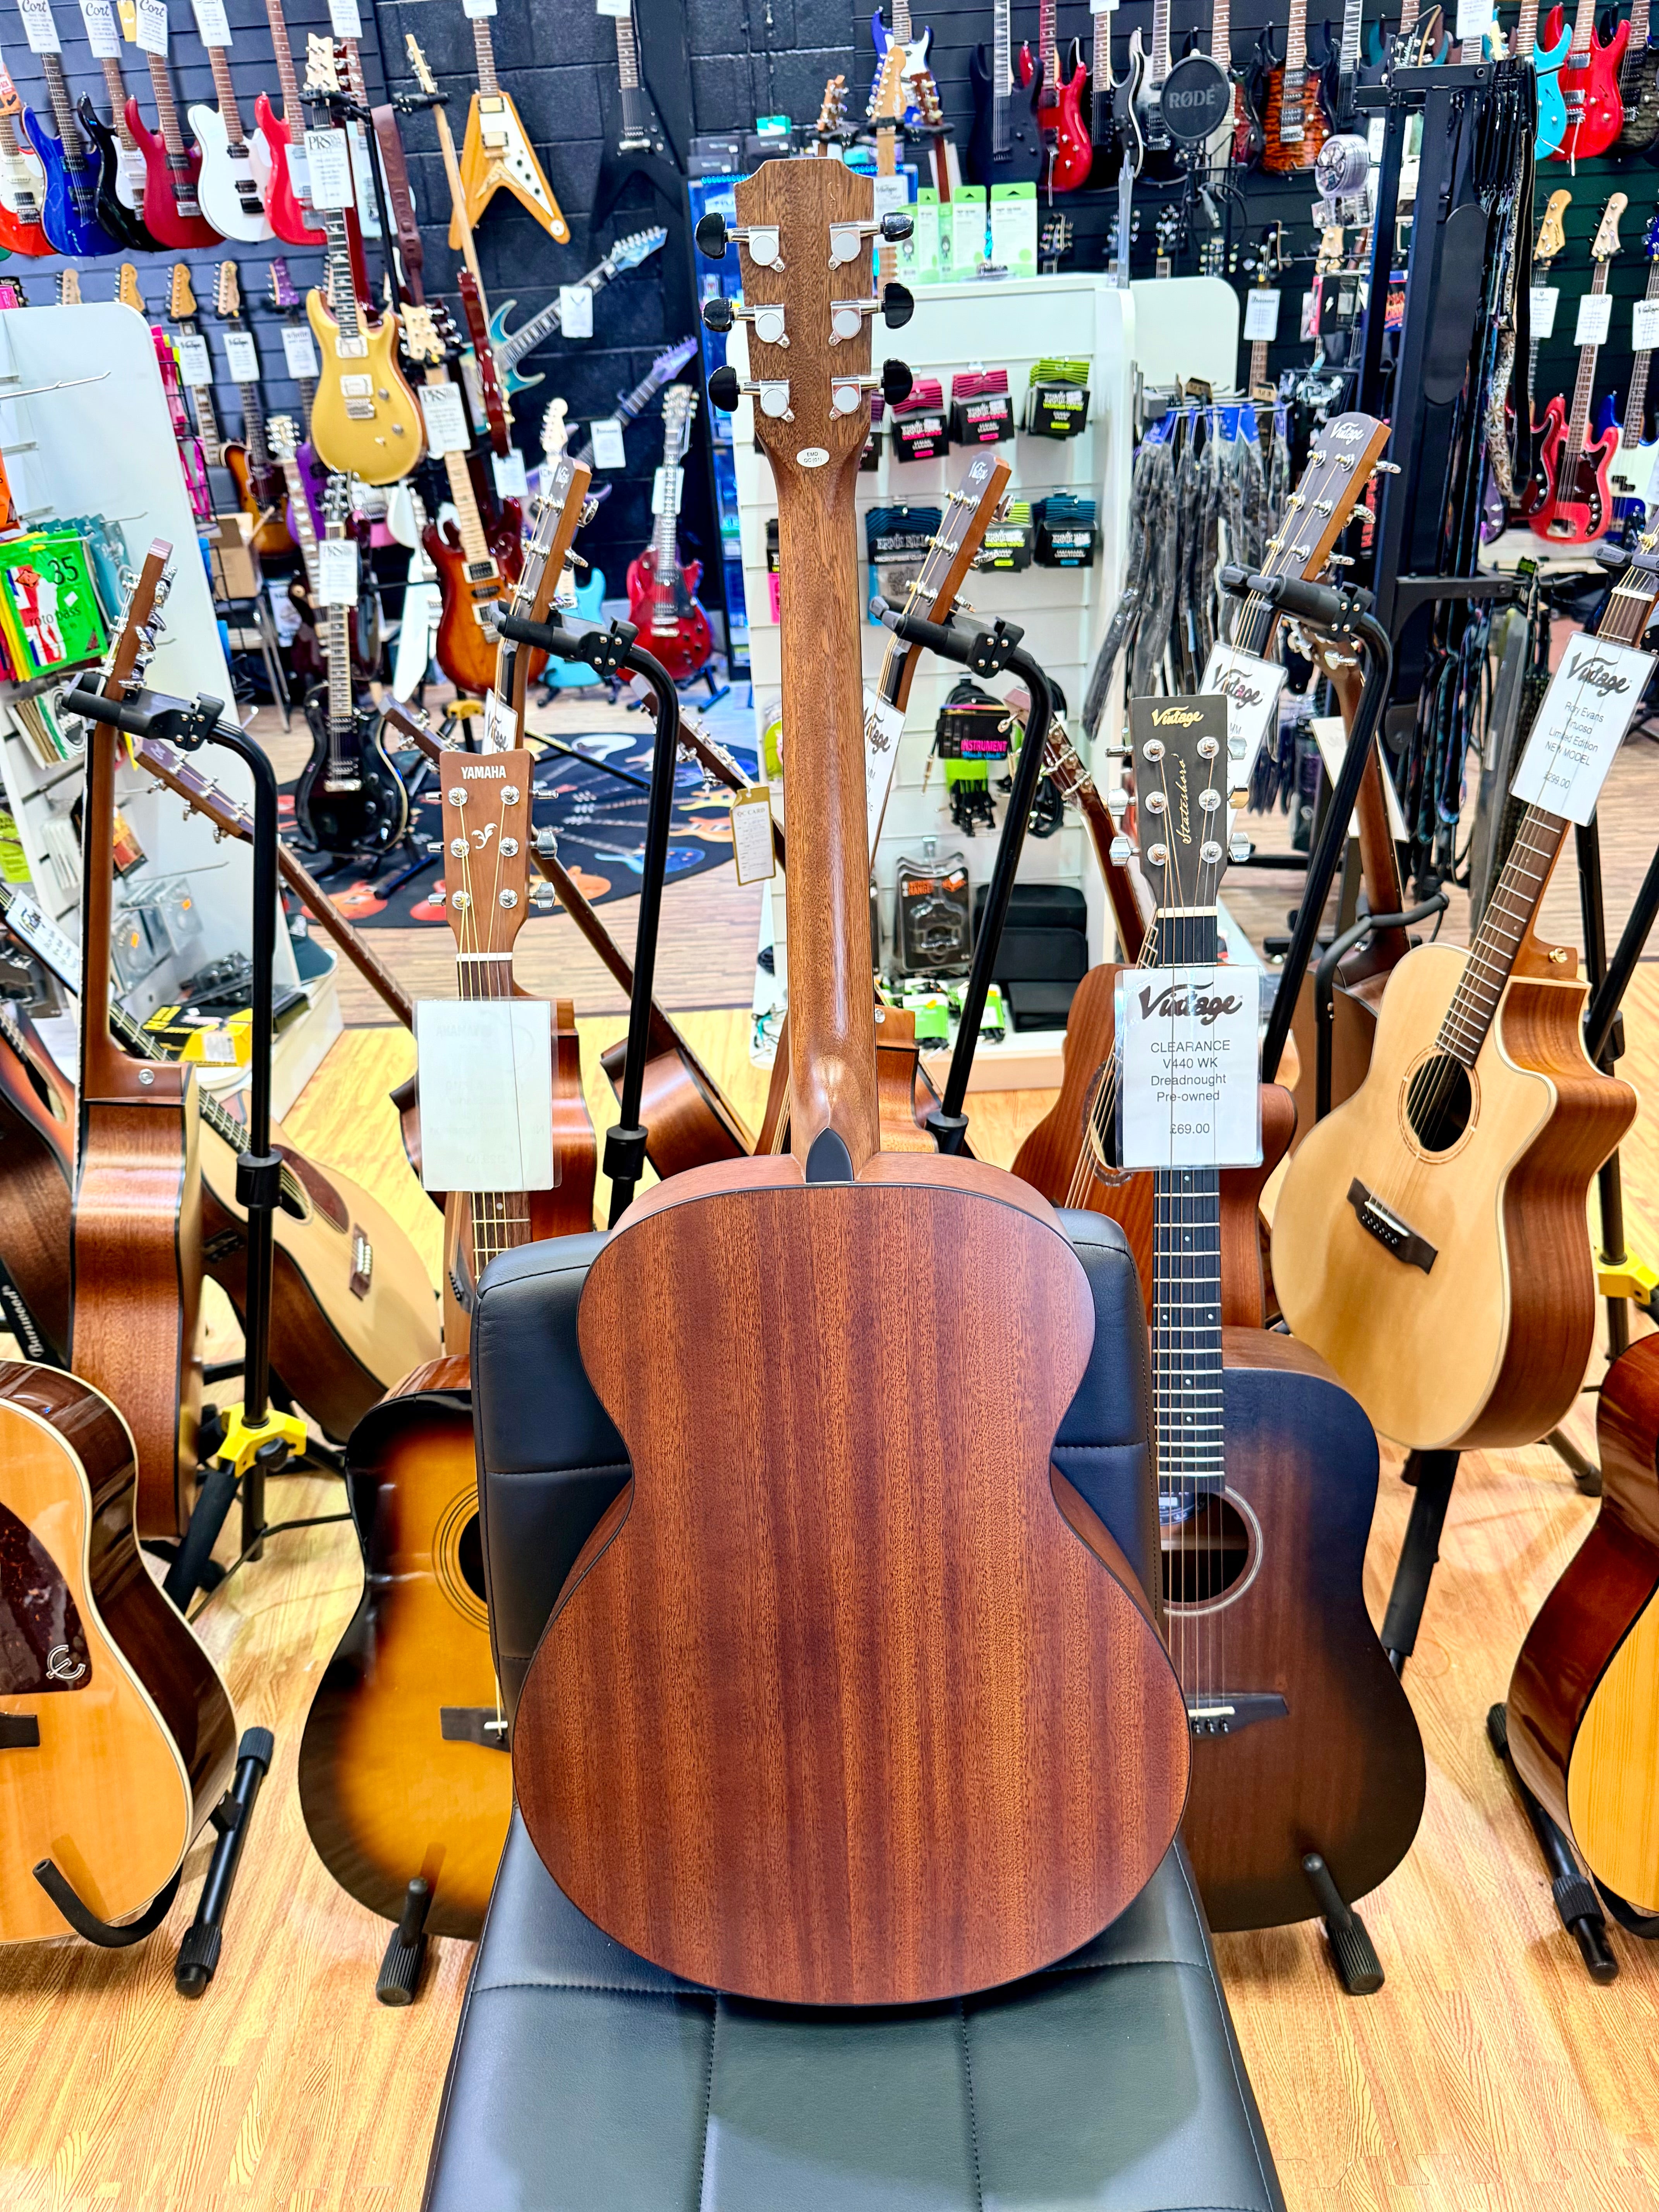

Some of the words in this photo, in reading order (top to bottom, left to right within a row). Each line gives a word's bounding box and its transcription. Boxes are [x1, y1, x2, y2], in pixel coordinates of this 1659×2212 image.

[86, 3, 110, 17] Cort
[140, 0, 165, 17] Cort
[1330, 421, 1364, 445] Vintage
[47, 556, 79, 585] 35
[30, 614, 54, 627] roto
[55, 606, 81, 622] bass
[1566, 652, 1631, 697] Vintage
[1151, 706, 1204, 728] Vintage
[1580, 707, 1604, 723] Evans
[961, 740, 1008, 752] INSTRUMENT
[1573, 736, 1598, 752] Edition
[1562, 747, 1590, 766] MODEL
[461, 765, 507, 780] YAMAHA
[1139, 981, 1243, 1026] Vintage
[1151, 1040, 1230, 1053] CLEARANCE
[1163, 1058, 1193, 1069] V440
[1197, 1057, 1218, 1068] WK
[1151, 1074, 1226, 1086] Dreadnought
[1157, 1090, 1220, 1102] Pre-owned
[1170, 1123, 1210, 1134] £69.00
